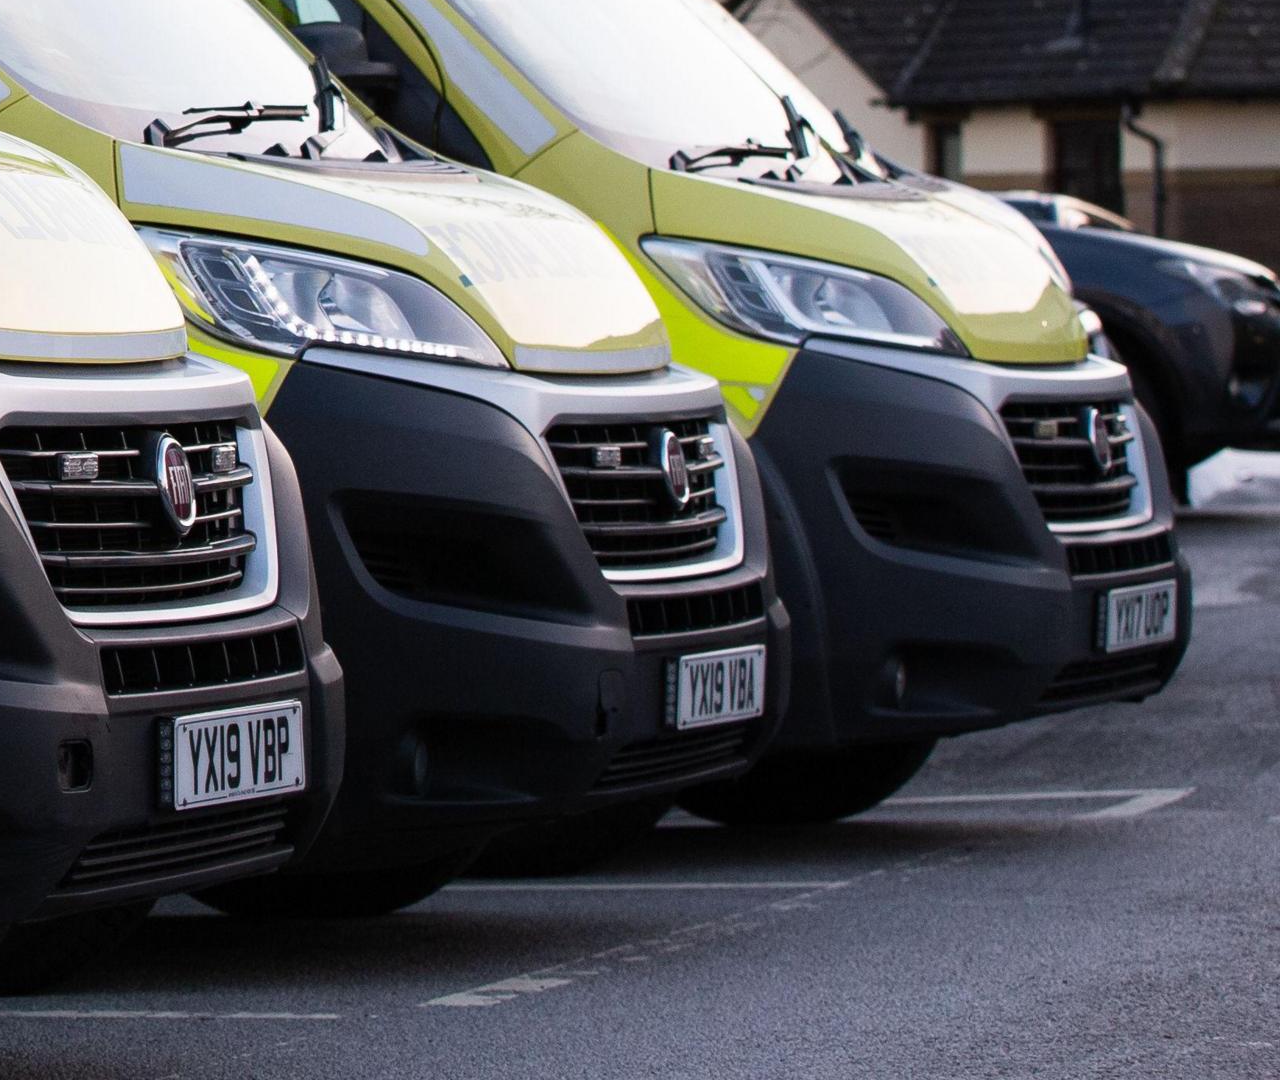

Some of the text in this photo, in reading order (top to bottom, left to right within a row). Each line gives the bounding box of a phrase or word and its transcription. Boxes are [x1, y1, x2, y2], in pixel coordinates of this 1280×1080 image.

[168, 465, 191, 505] FIAT
[1115, 594, 1142, 643] YX17
[688, 655, 755, 718] YX19 VBA
[188, 715, 290, 796] YX19 VBP
